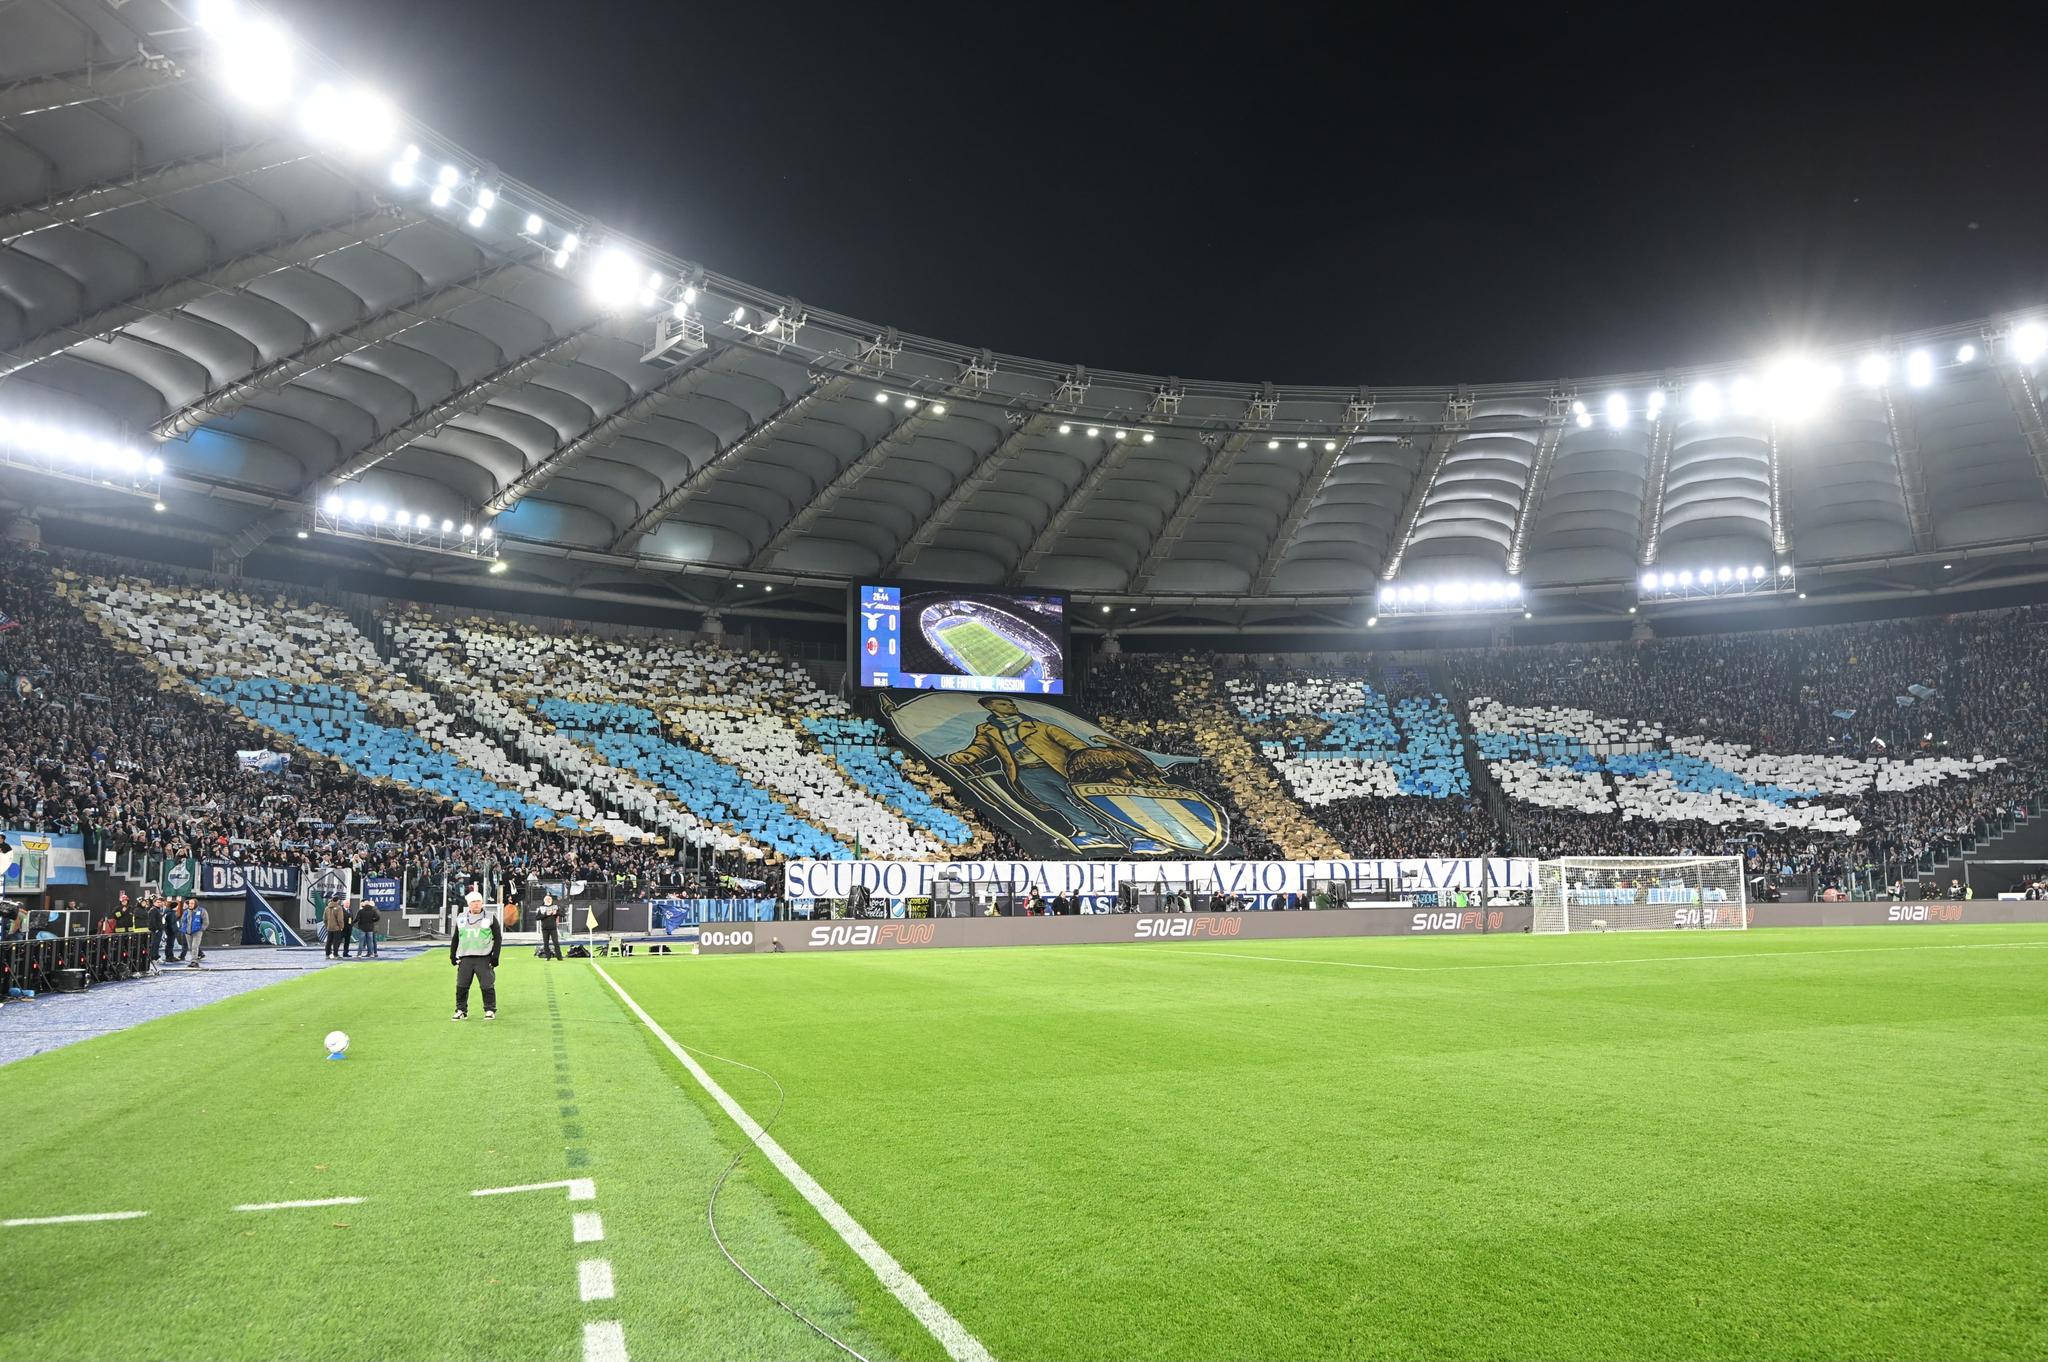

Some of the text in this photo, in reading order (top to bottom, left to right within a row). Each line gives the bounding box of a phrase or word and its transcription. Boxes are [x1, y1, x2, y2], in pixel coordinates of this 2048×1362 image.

[888, 614, 896, 631] 0
[888, 638, 896, 655] 0
[1083, 786, 1139, 795] CURVA
[788, 862, 907, 898] SCUDO
[945, 862, 1055, 896] SPADA
[1182, 862, 1287, 893] LAZIO
[465, 928, 480, 938] TV
[700, 931, 753, 946] 00:00
